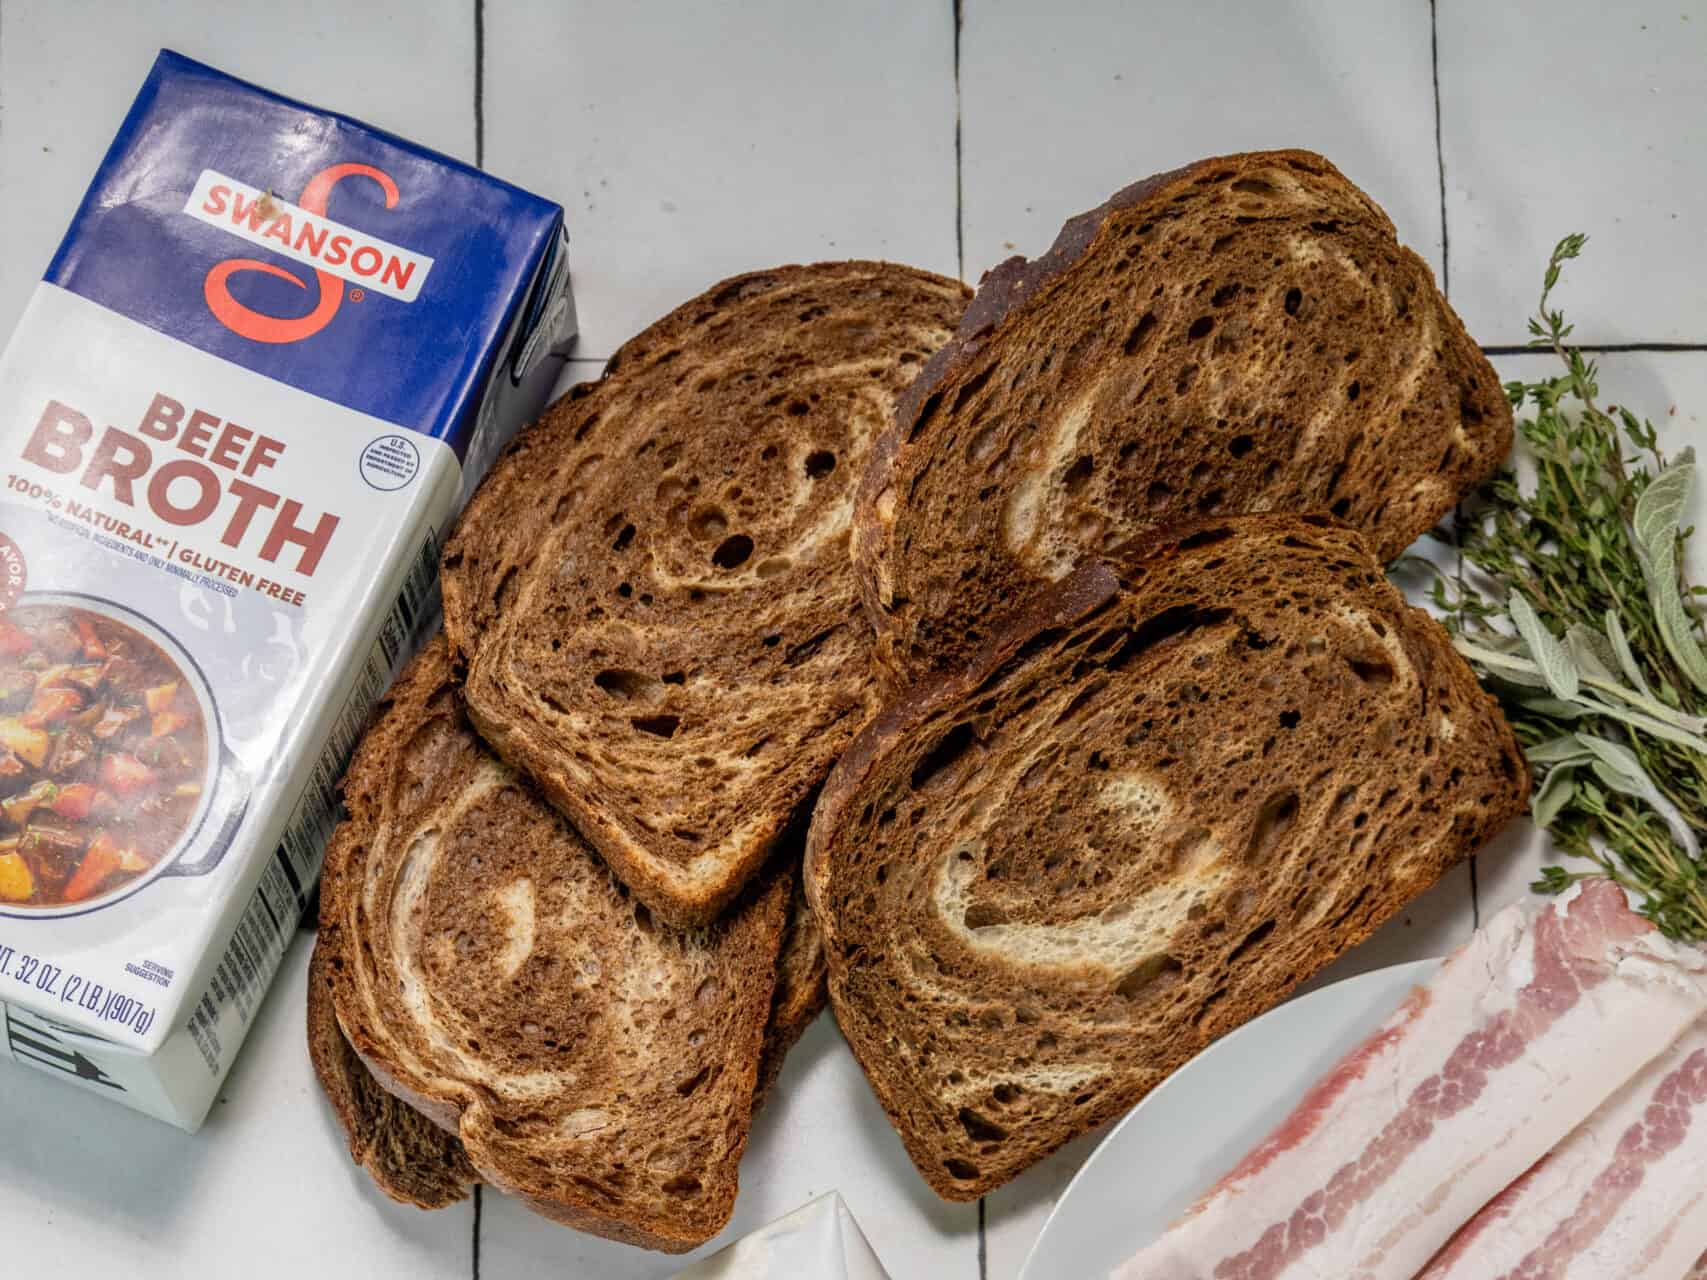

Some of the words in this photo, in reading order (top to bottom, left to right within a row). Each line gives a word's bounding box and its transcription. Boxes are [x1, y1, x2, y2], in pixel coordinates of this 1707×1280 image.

[202, 184, 417, 291] SWANSON
[138, 391, 287, 478] BEEF
[21, 399, 341, 577] BROTH
[7, 473, 63, 509] 100%
[178, 548, 254, 587] GLUTEN
[255, 577, 307, 607] FREE
[15, 955, 40, 985] 32
[36, 963, 62, 995] OZ.
[124, 962, 172, 988] SUGGESTION
[142, 959, 175, 980] SERVING
